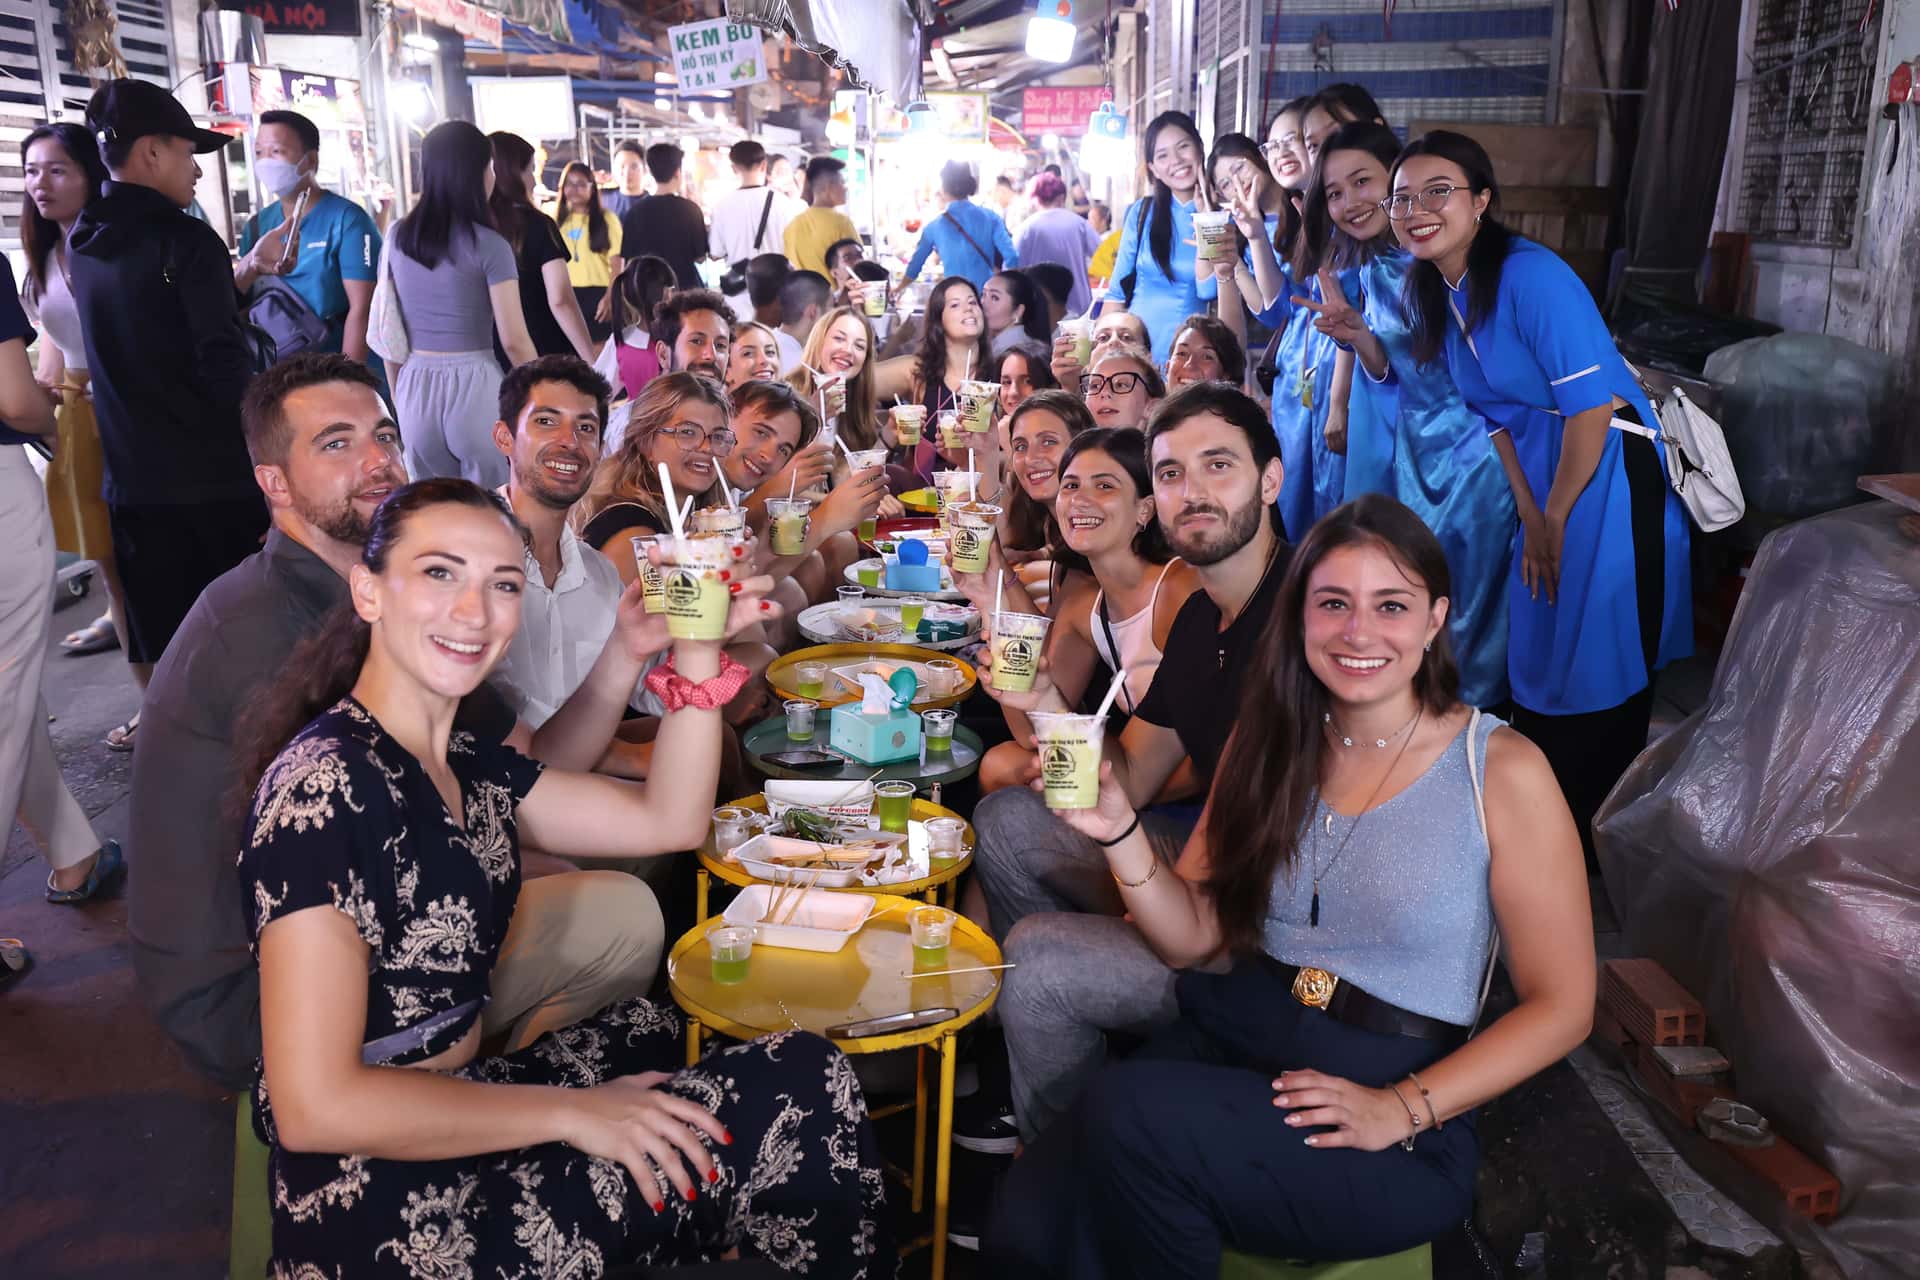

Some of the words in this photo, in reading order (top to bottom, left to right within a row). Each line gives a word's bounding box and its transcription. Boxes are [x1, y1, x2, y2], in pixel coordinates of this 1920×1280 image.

[676, 28, 720, 51] KEM
[684, 74, 690, 88] T
[707, 70, 716, 84] N
